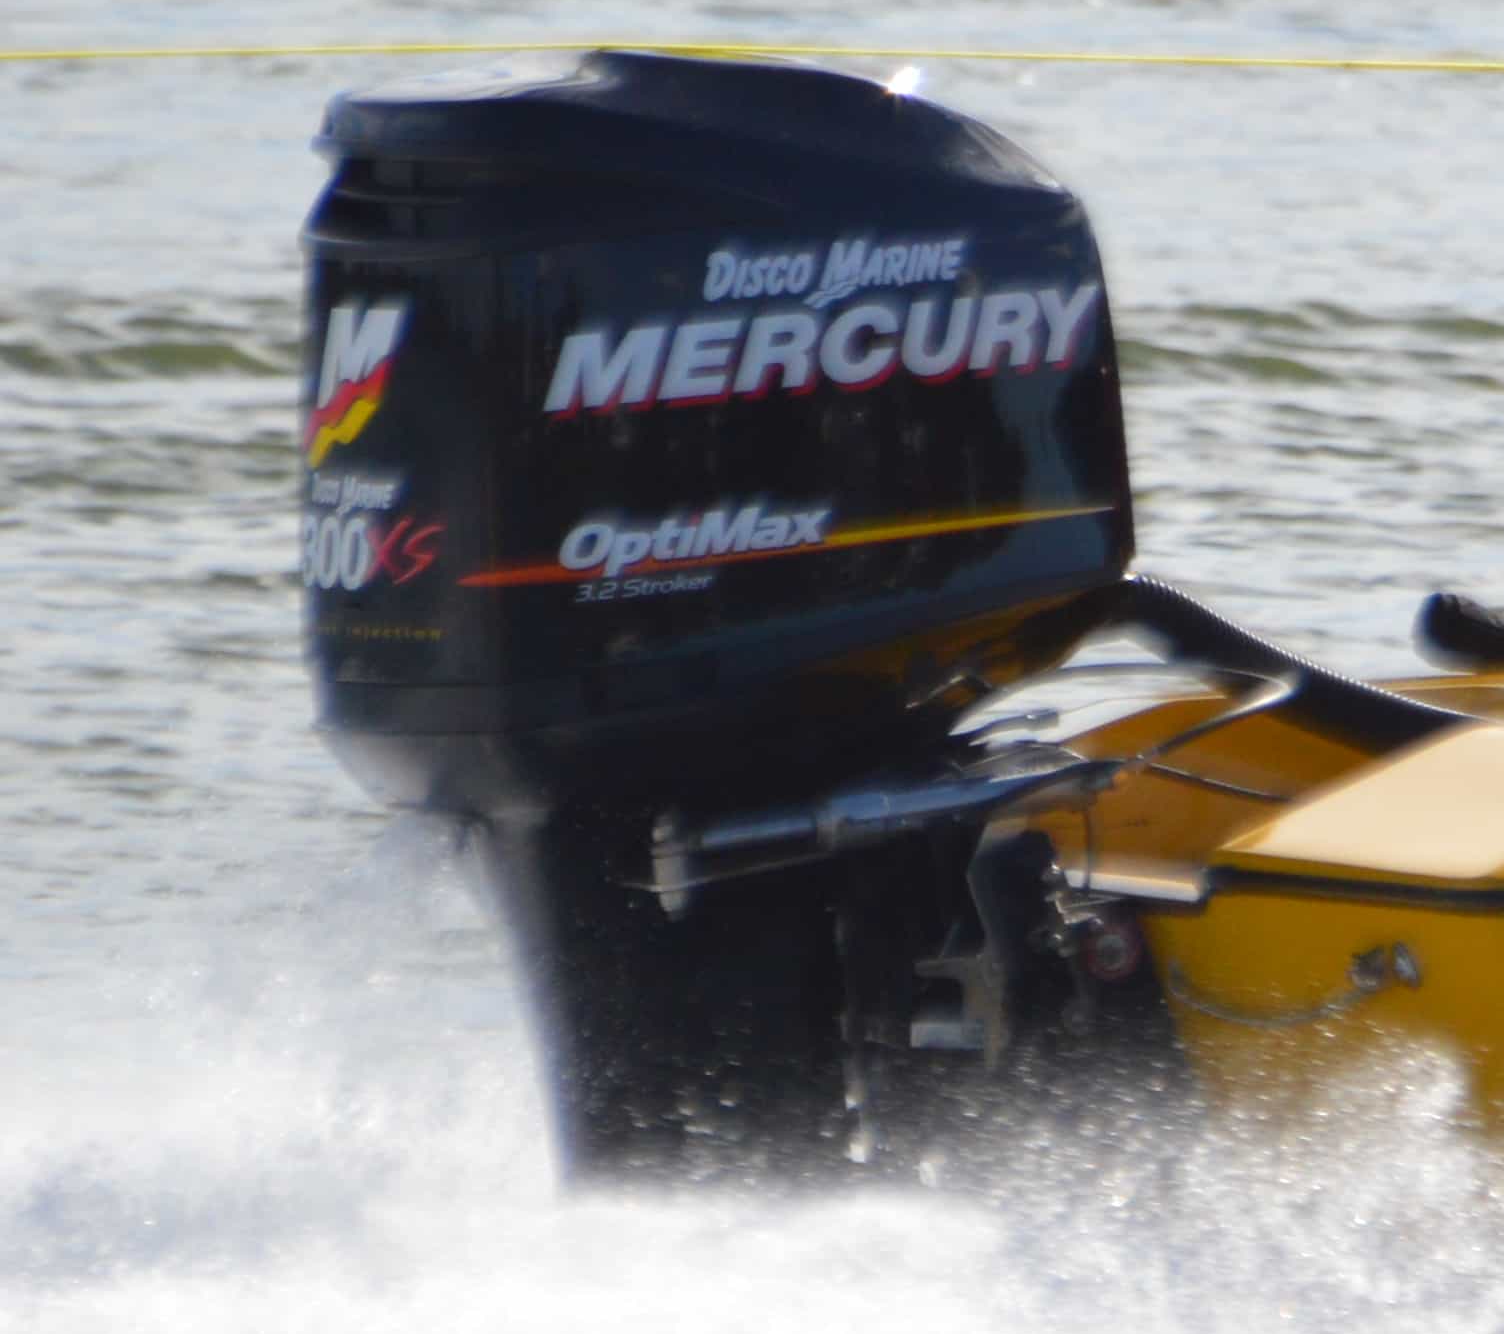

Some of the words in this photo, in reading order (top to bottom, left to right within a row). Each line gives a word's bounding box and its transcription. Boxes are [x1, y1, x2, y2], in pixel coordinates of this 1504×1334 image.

[542, 285, 1098, 419] MERCURY
[557, 505, 832, 578] OptiMax
[575, 581, 616, 604] 3.2
[621, 572, 714, 600] Stroker
